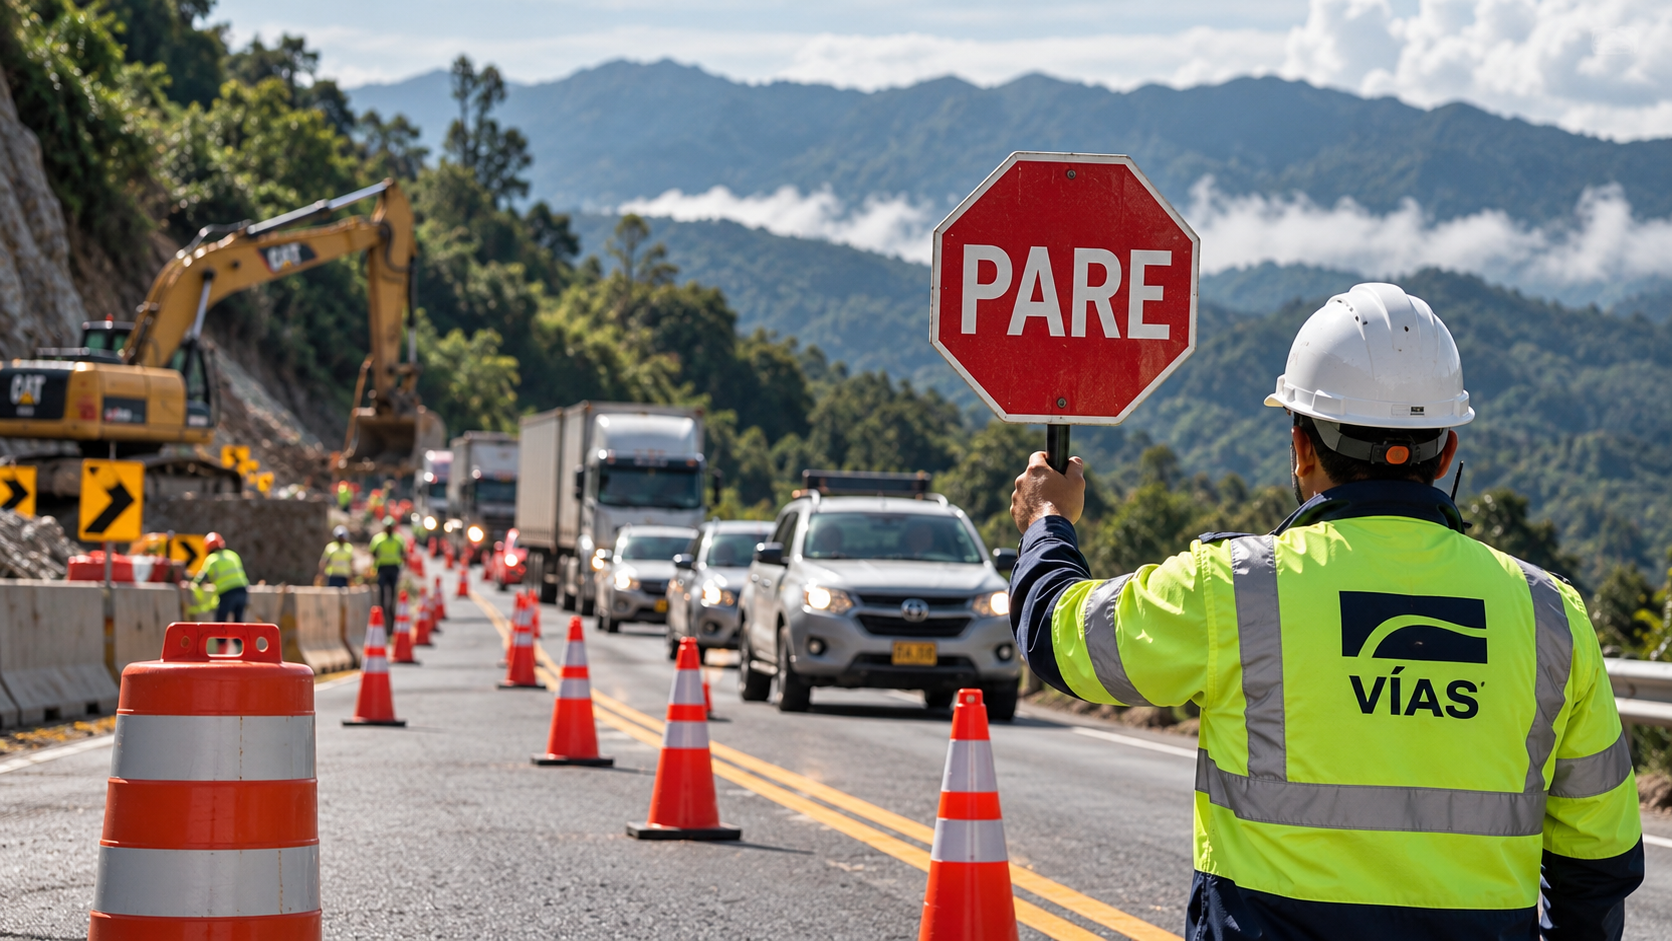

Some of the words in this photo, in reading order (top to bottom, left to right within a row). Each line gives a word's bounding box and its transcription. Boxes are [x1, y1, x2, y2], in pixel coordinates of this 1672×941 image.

[267, 242, 302, 271] CAT
[961, 244, 1172, 340] PARE
[10, 374, 46, 405] CAT
